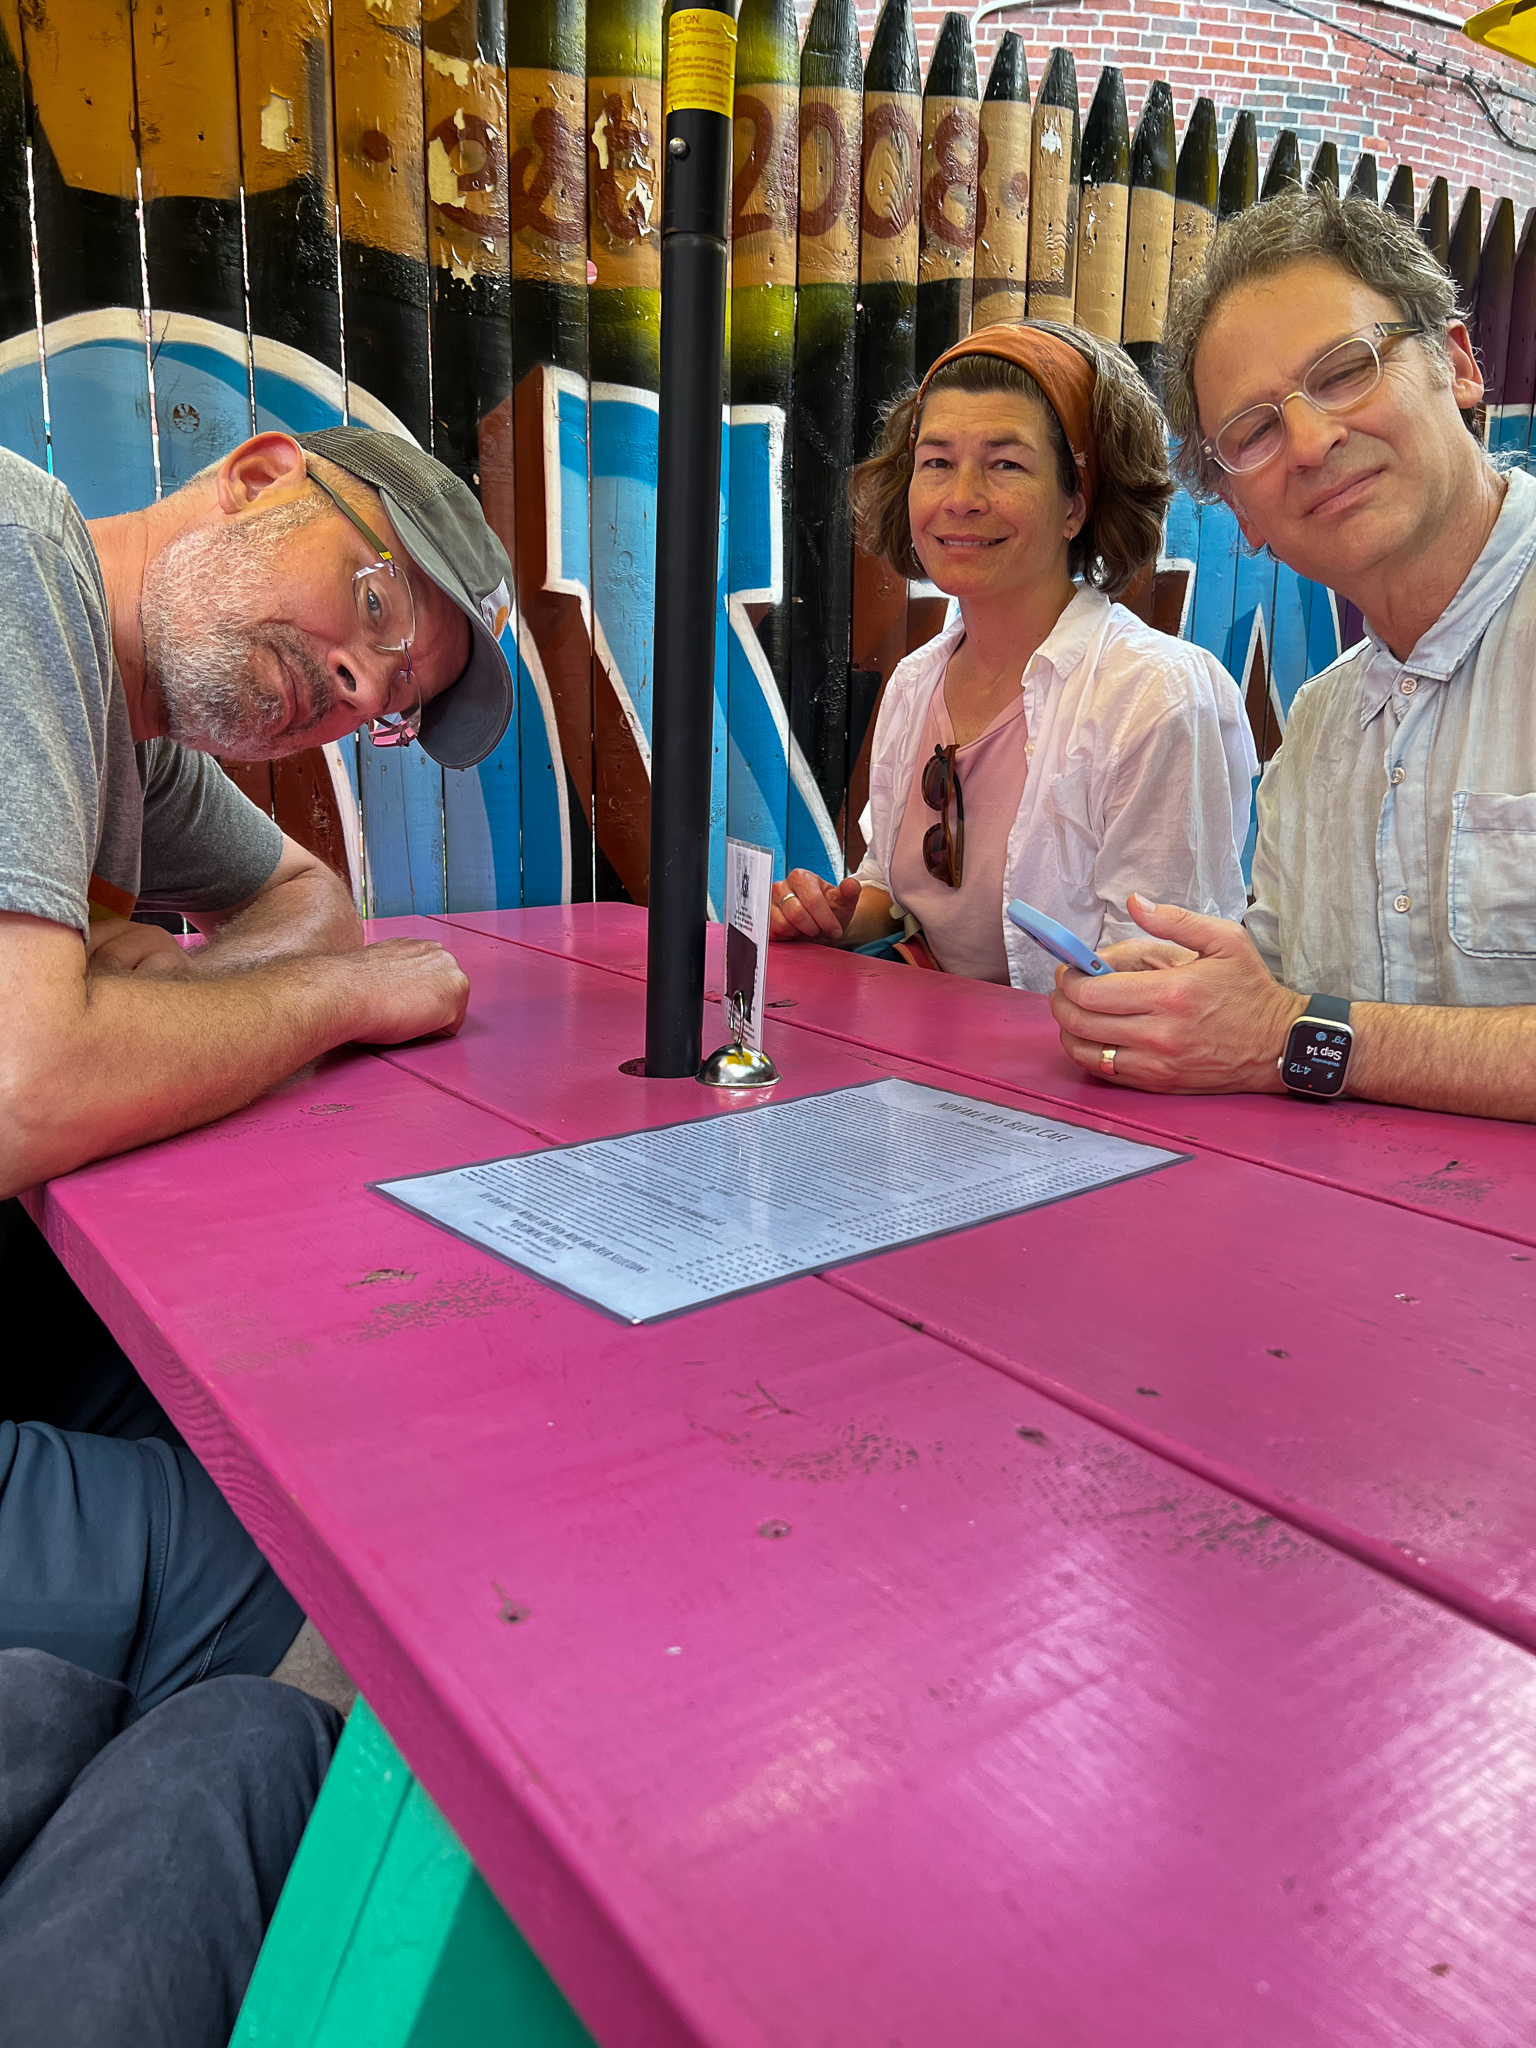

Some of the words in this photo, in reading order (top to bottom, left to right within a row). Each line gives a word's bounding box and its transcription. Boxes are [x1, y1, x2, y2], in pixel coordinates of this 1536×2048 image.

[671, 15, 702, 28] AUTION:
[731, 95, 988, 249] 2008
[1306, 1045, 1319, 1056] 14
[1320, 1046, 1343, 1061] Sep
[1289, 1062, 1312, 1075] 4:12
